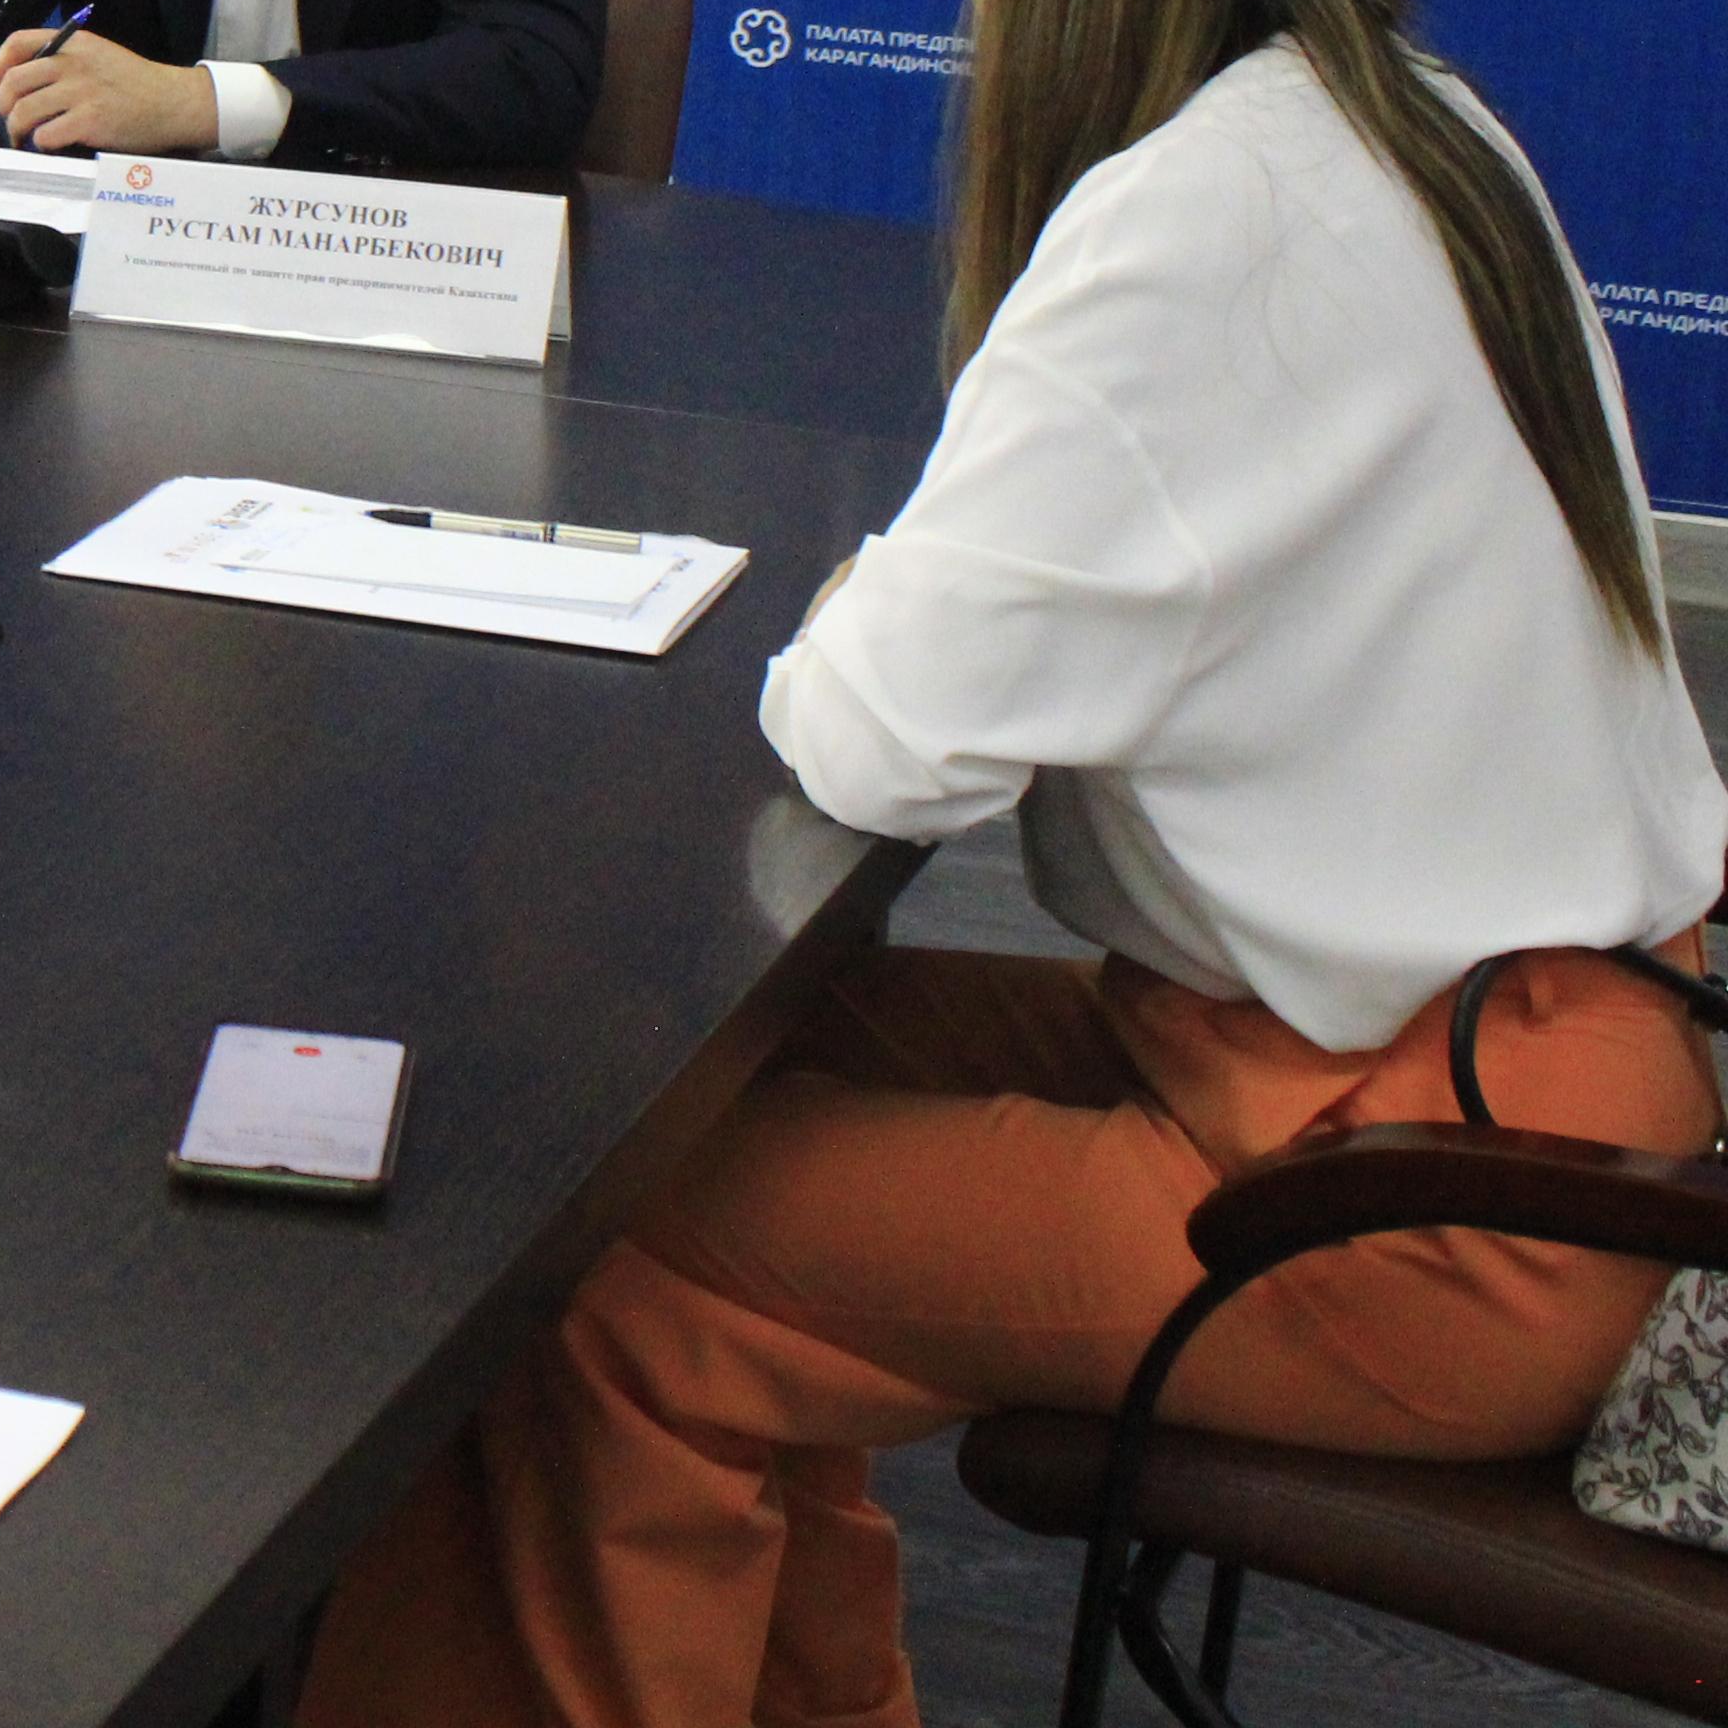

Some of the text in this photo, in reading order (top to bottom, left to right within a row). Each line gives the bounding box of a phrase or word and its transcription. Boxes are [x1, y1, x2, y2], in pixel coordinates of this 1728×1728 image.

[806, 24, 885, 45] ПАЛАТА
[96, 189, 175, 208] АТАМЕКЕН
[249, 195, 408, 229] ЖУРСУНОВ
[147, 216, 504, 270] РУСТАМ МАНАРБЕКОВИЧ
[1589, 282, 1728, 314] АЛАТА ПРЕД
